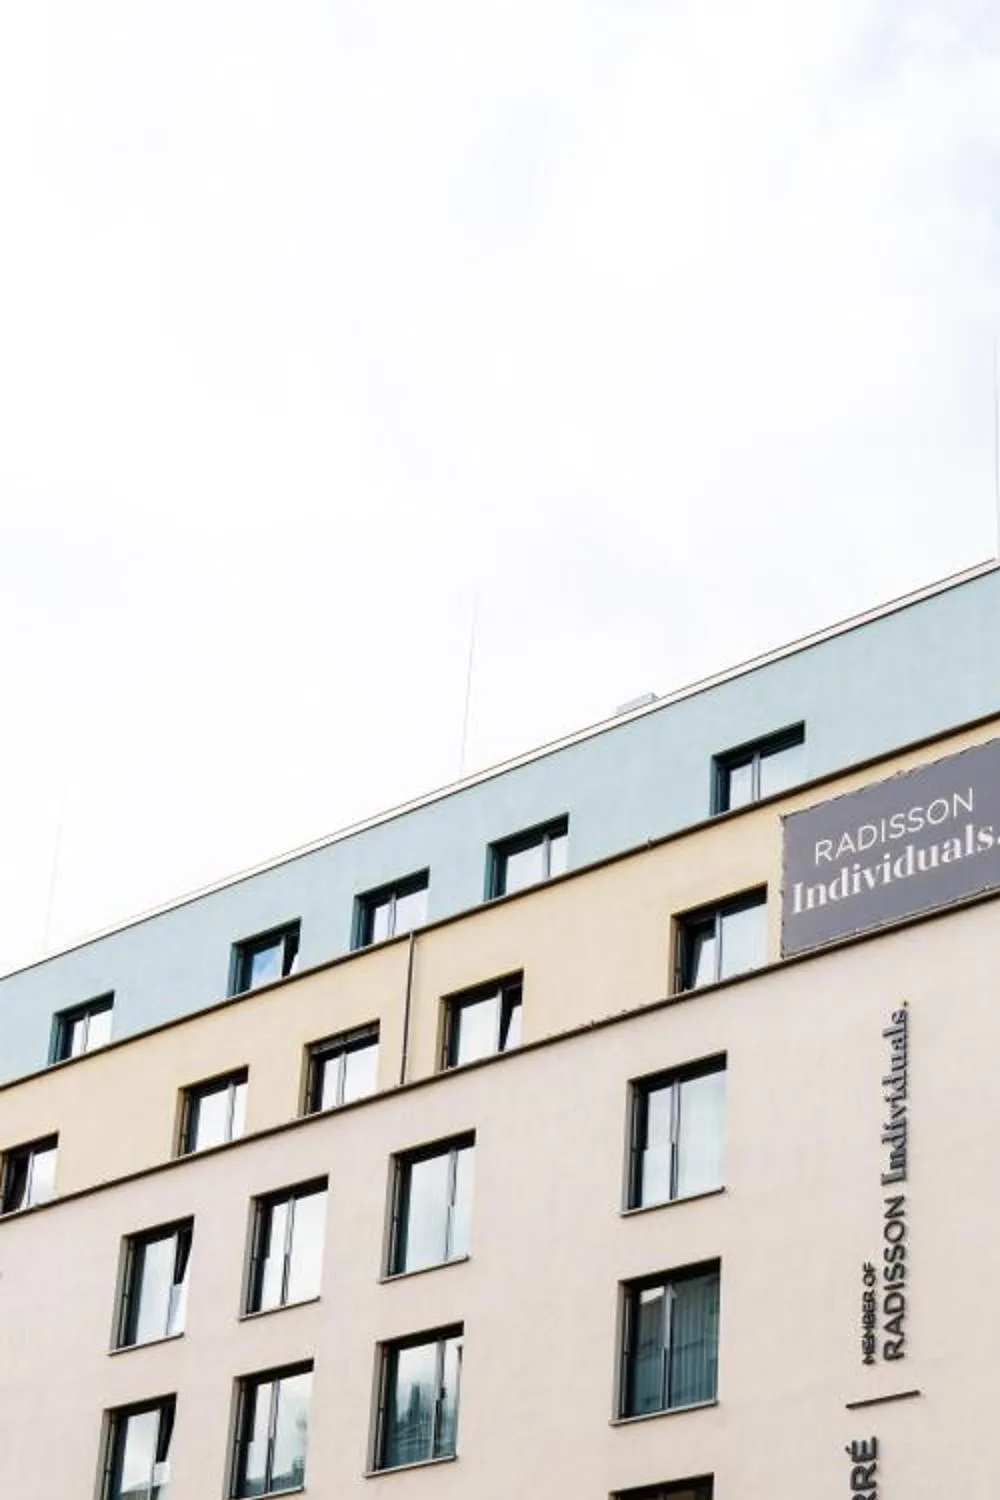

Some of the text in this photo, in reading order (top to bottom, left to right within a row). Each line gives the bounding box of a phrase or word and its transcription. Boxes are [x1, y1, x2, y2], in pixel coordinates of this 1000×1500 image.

[814, 786, 975, 867] RADISSON
[880, 1000, 909, 1362] RADISSON Individuals.
[861, 1261, 877, 1366] MEMBER OF
